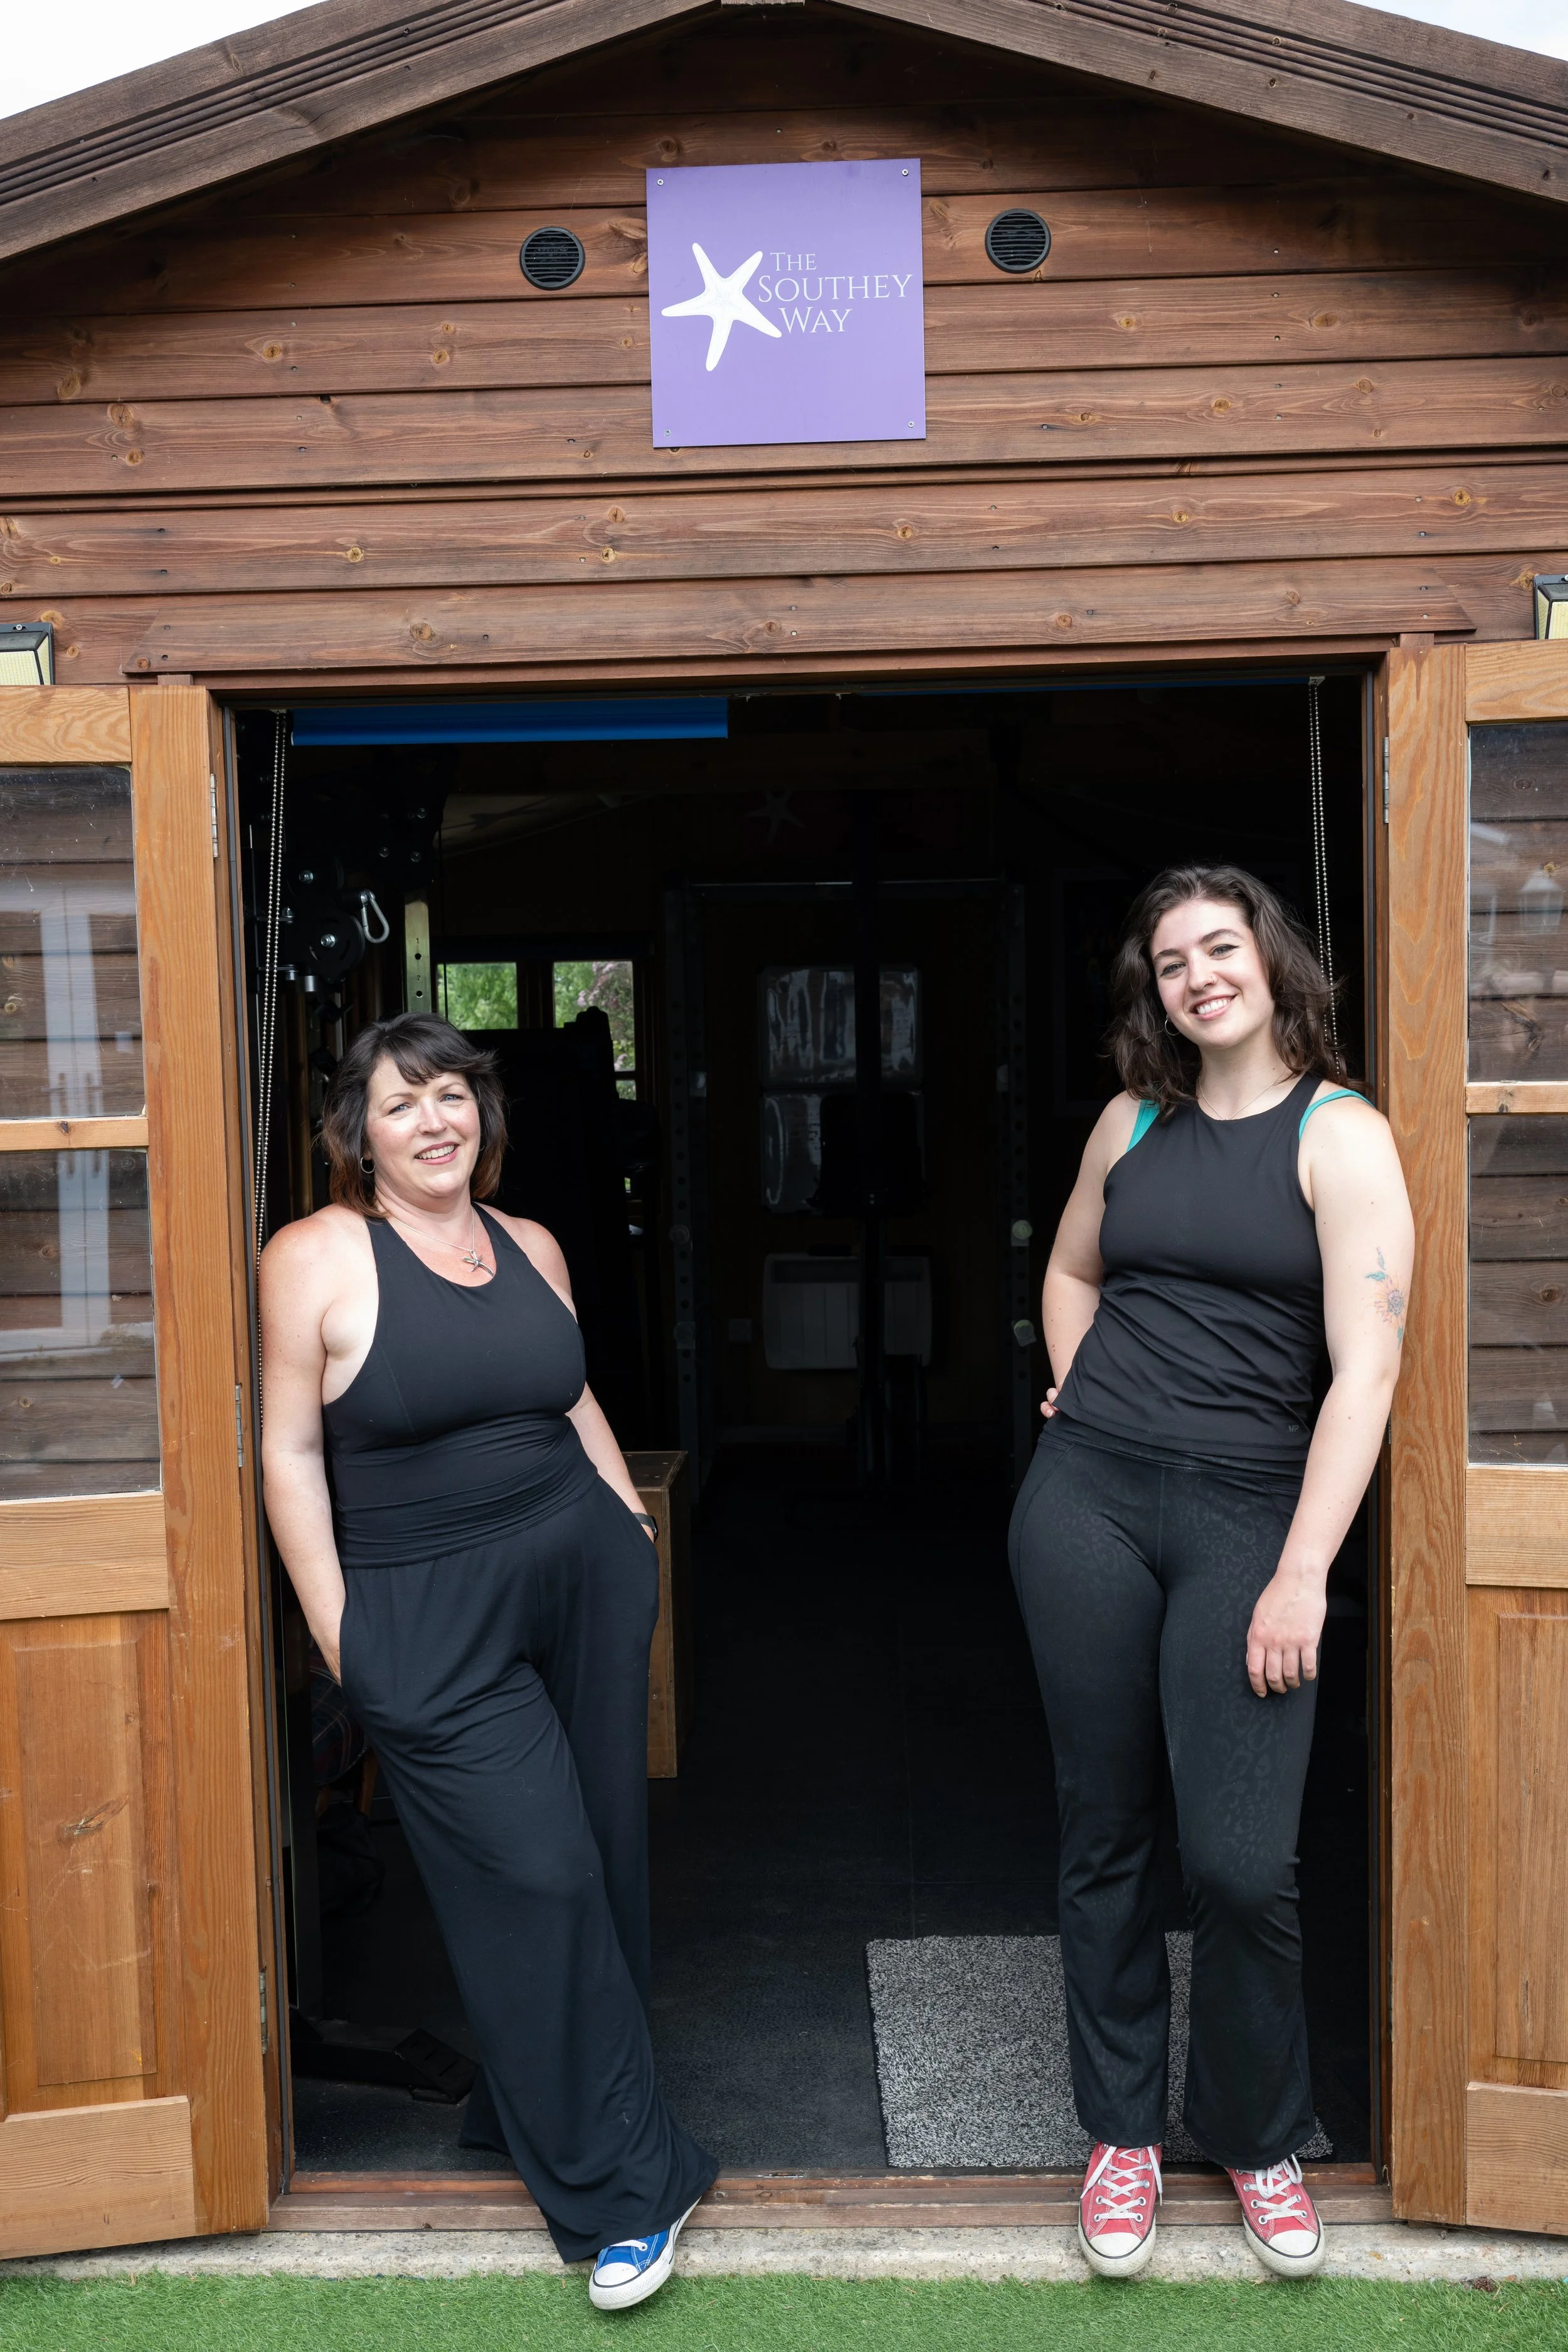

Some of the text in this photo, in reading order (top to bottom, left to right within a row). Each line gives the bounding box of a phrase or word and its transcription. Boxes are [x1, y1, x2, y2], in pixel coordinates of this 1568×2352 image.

[770, 252, 817, 272] THE
[758, 274, 914, 302] SOUTHEY
[779, 307, 853, 334] WAY
